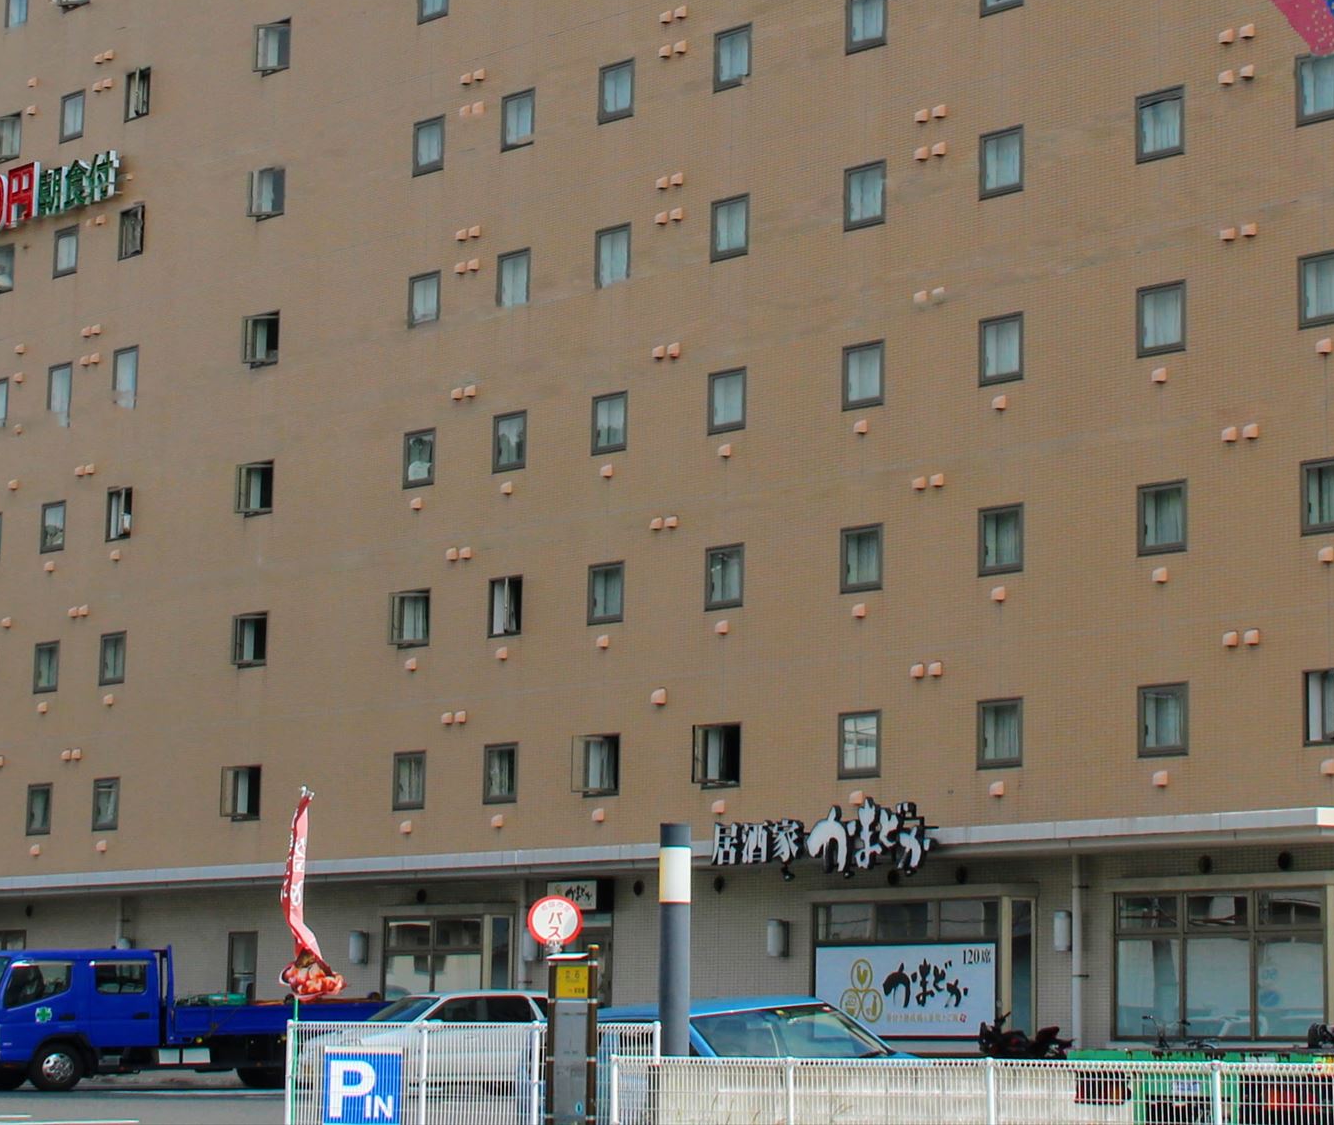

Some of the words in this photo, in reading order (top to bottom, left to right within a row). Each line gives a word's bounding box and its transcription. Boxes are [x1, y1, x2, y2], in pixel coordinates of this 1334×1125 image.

[548, 912, 563, 938] バス
[882, 957, 969, 1009] かまどか
